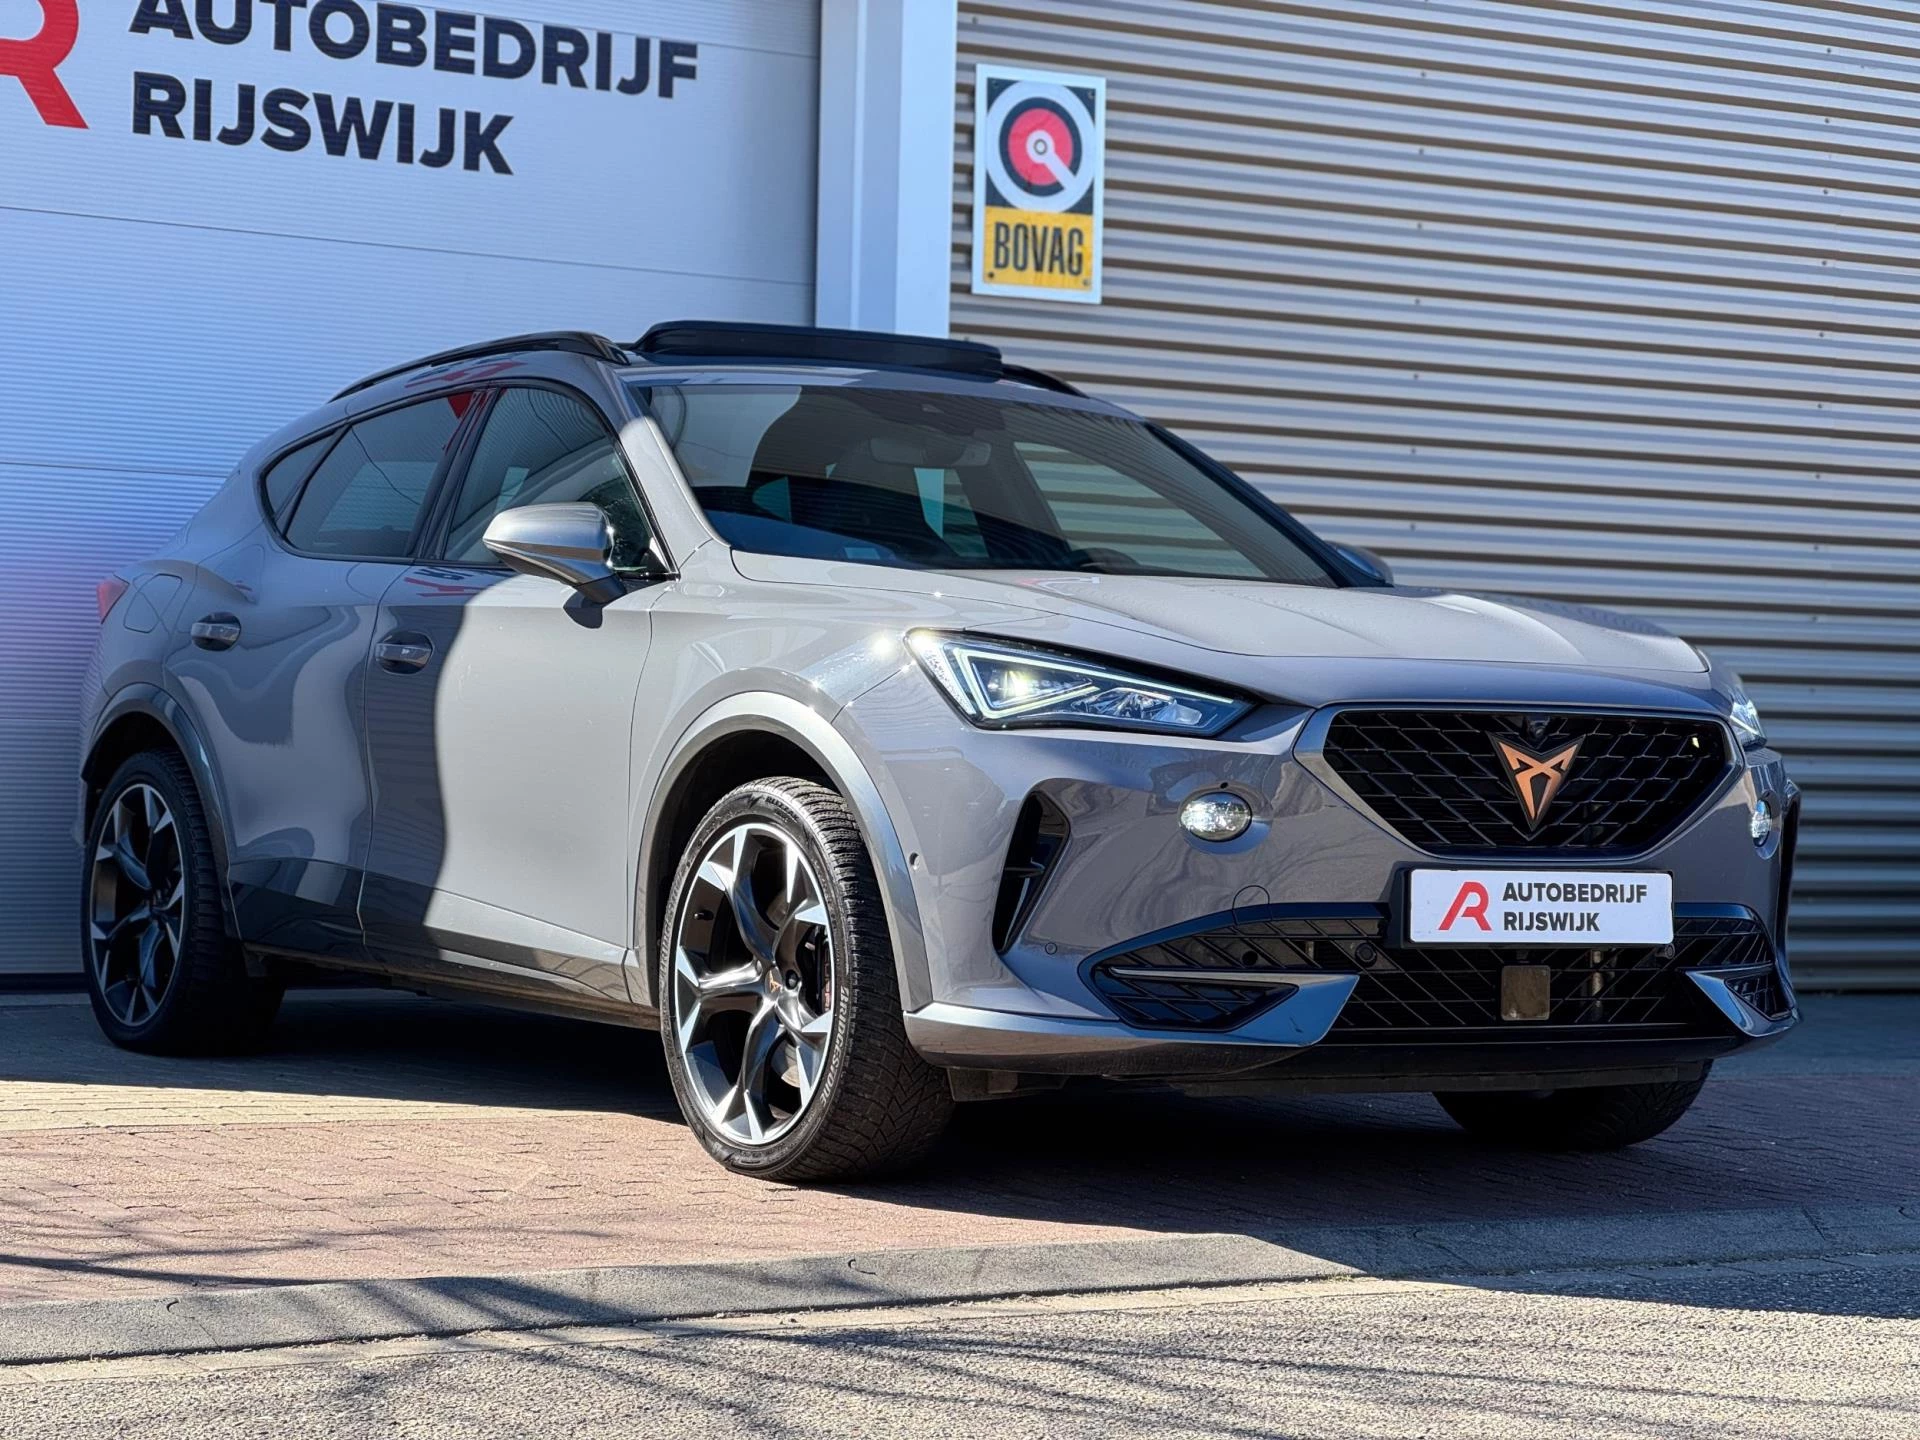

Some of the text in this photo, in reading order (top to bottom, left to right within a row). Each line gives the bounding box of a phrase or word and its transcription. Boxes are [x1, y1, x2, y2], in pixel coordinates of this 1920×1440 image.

[128, 0, 699, 99] AUTOBEDRIJF
[132, 71, 514, 176] RIJSWIJK
[993, 221, 1084, 276] BOVAG
[1502, 882, 1648, 904] AUTOBEDRIJF
[1503, 911, 1601, 932] RIJSWIJK
[819, 985, 850, 1108] BRIDGESTONE
